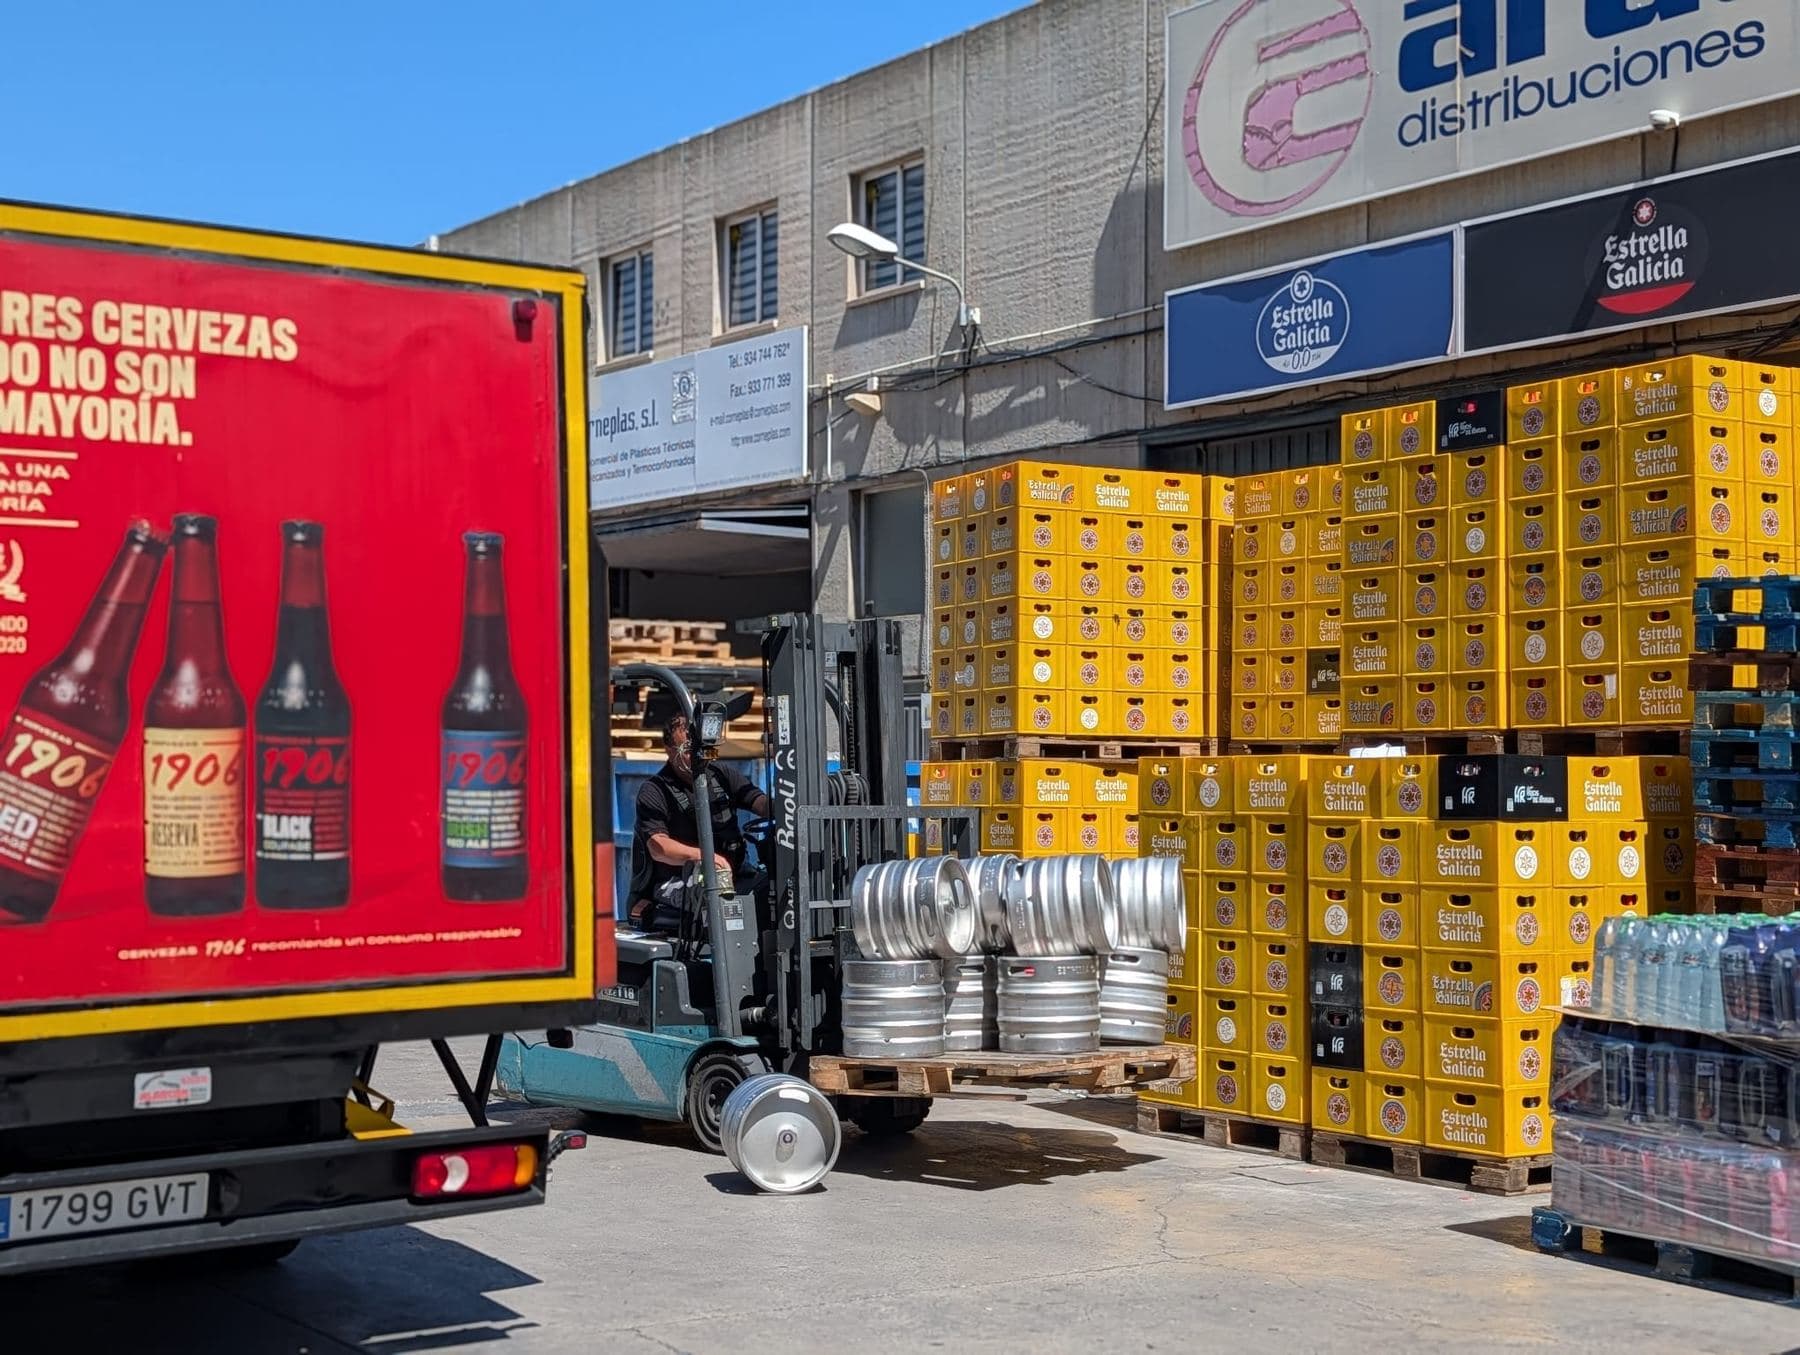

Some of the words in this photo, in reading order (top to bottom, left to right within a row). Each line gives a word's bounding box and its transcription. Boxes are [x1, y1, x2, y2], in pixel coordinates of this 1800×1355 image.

[1398, 20, 1766, 148] distribuciones
[1603, 224, 1688, 263] Estrella
[1606, 253, 1685, 290] Galicia
[1271, 297, 1334, 329] Estrella
[92, 300, 298, 362] CERVEZAS
[1273, 321, 1330, 352] Galicia
[49, 344, 107, 393] NO
[115, 351, 196, 399] SON
[1634, 384, 1678, 402] Estrella
[641, 399, 659, 429] s.l.
[1635, 399, 1676, 416] Galicia
[0, 389, 193, 446] MAYORÍA.
[1634, 444, 1678, 462] Estrella
[15, 463, 70, 480] UNA
[1636, 459, 1677, 477] Galicia
[1095, 484, 1130, 497] Estrella
[1156, 489, 1190, 502] Estrella
[1244, 492, 1271, 503] Estrella
[1354, 485, 1389, 498] Estrella
[1096, 495, 1129, 508] Galicia
[1157, 500, 1188, 513] Galicia
[1245, 502, 1270, 514] Galicia
[1354, 498, 1387, 513] Galicia
[1637, 566, 1681, 582] Estrella
[1638, 580, 1679, 597] Galicia
[1352, 591, 1387, 605] Estrella
[1352, 603, 1386, 618] Galicia
[1638, 625, 1682, 641] Estrella
[1352, 645, 1387, 658] Estrella
[1640, 638, 1681, 656] Galicia
[1353, 657, 1386, 672] Galicia
[1638, 686, 1683, 701] Estrella
[1640, 699, 1682, 716] Galicia
[5, 733, 112, 798] 1906
[151, 753, 240, 791] 1906
[447, 751, 527, 787] 1906
[928, 780, 950, 791] Estrella
[1037, 779, 1070, 791] Estrella
[1095, 779, 1128, 791] Estrella
[1248, 778, 1287, 793] Estrella
[1323, 781, 1366, 796] Estrella
[1584, 780, 1622, 797] Estrella
[928, 789, 950, 802] Galicia
[1037, 790, 1069, 802] Galicia
[1096, 790, 1127, 802] Galicia
[1250, 793, 1286, 808] Galicia
[1324, 795, 1364, 811] Galicia
[1462, 787, 1475, 804] HR
[1584, 796, 1621, 813] Galicia
[263, 814, 313, 840] BLACK
[1151, 835, 1187, 849] Estrella
[1436, 844, 1483, 860] Estrella
[1437, 860, 1481, 877] Galicia
[1437, 908, 1484, 928] Estrella
[1438, 925, 1482, 943] Galicia
[206, 938, 246, 957] 1906
[1440, 1042, 1487, 1061] Estrella
[1441, 1058, 1485, 1078] Galicia
[1441, 1108, 1488, 1128] Estrella
[1443, 1125, 1487, 1145] Galicia
[19, 1189, 113, 1232] 1799
[127, 1181, 197, 1224] GVT
